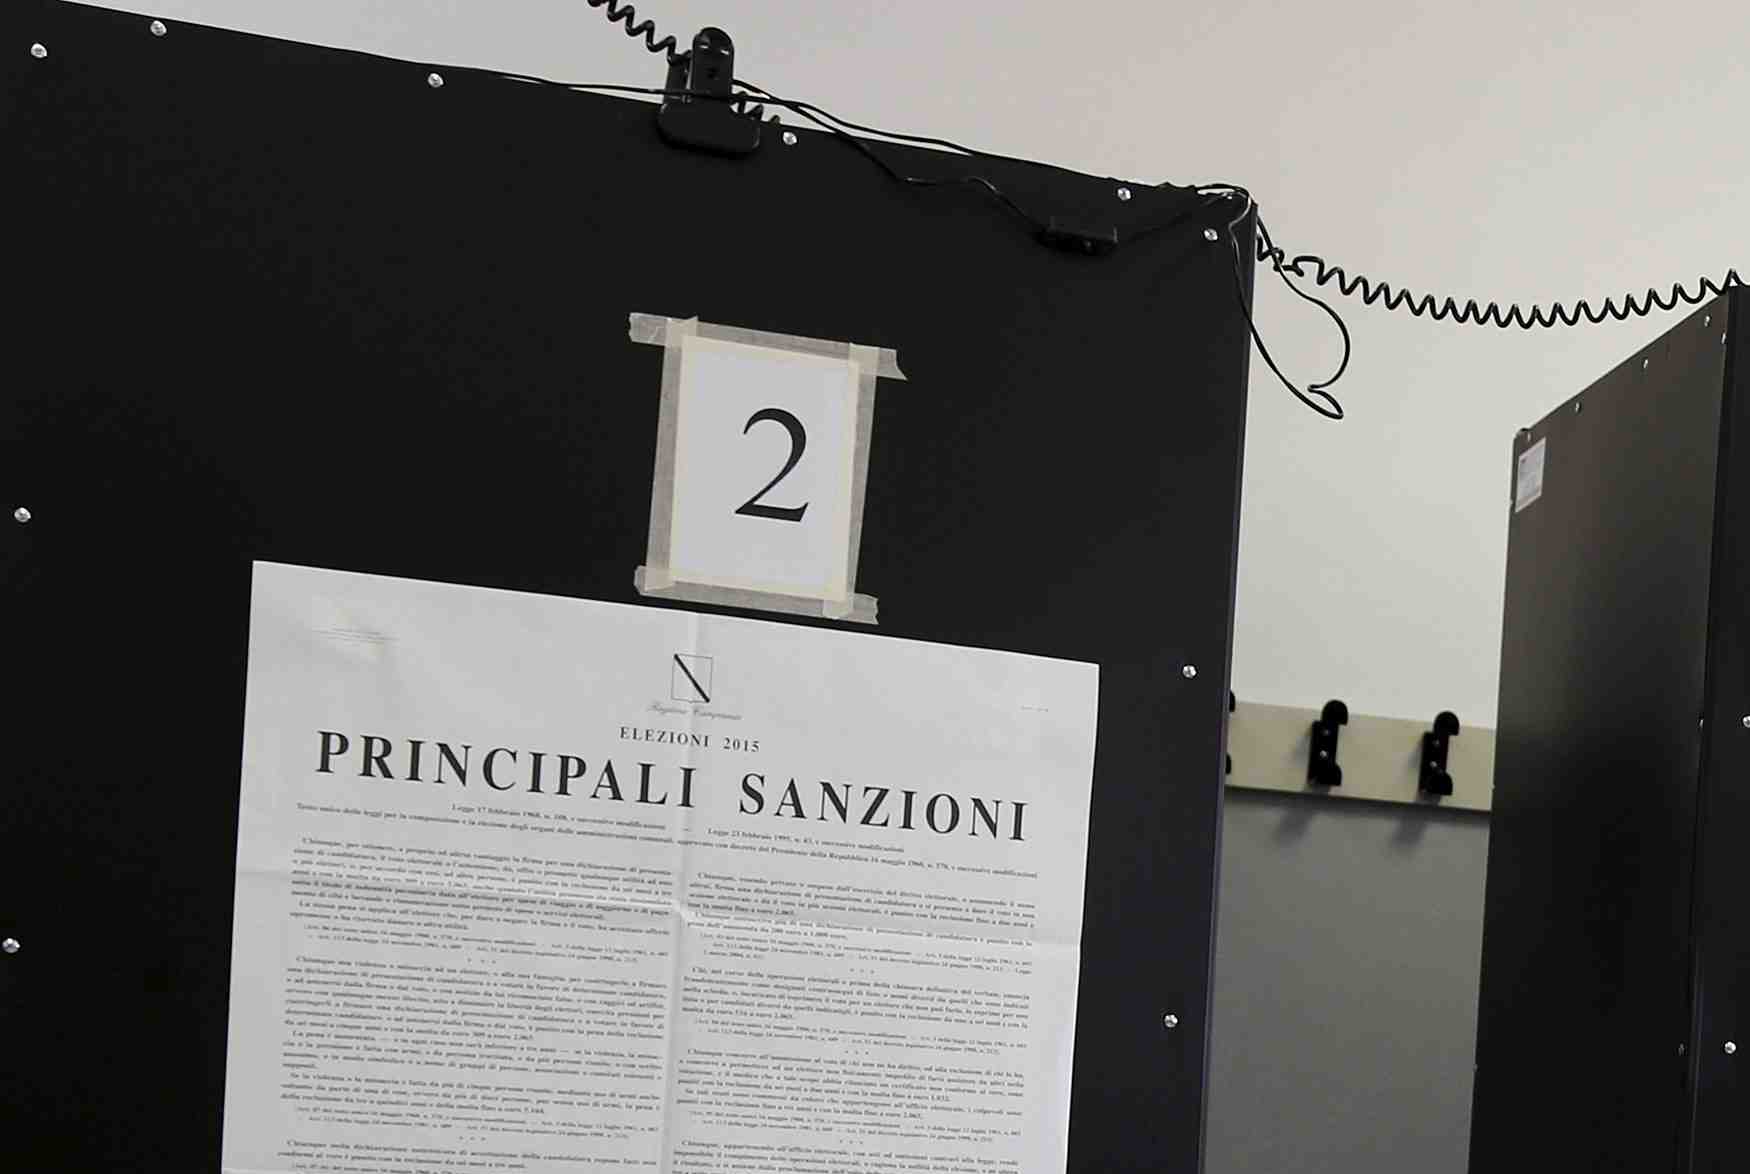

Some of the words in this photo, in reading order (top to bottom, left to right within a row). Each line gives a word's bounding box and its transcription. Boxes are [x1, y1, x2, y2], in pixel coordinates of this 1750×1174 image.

[734, 408, 809, 522] 2
[315, 730, 697, 808] PRINCIPALI
[738, 772, 1029, 842] SANZIONI
[620, 726, 710, 747] ELEZIONI
[722, 736, 761, 753] 2015
